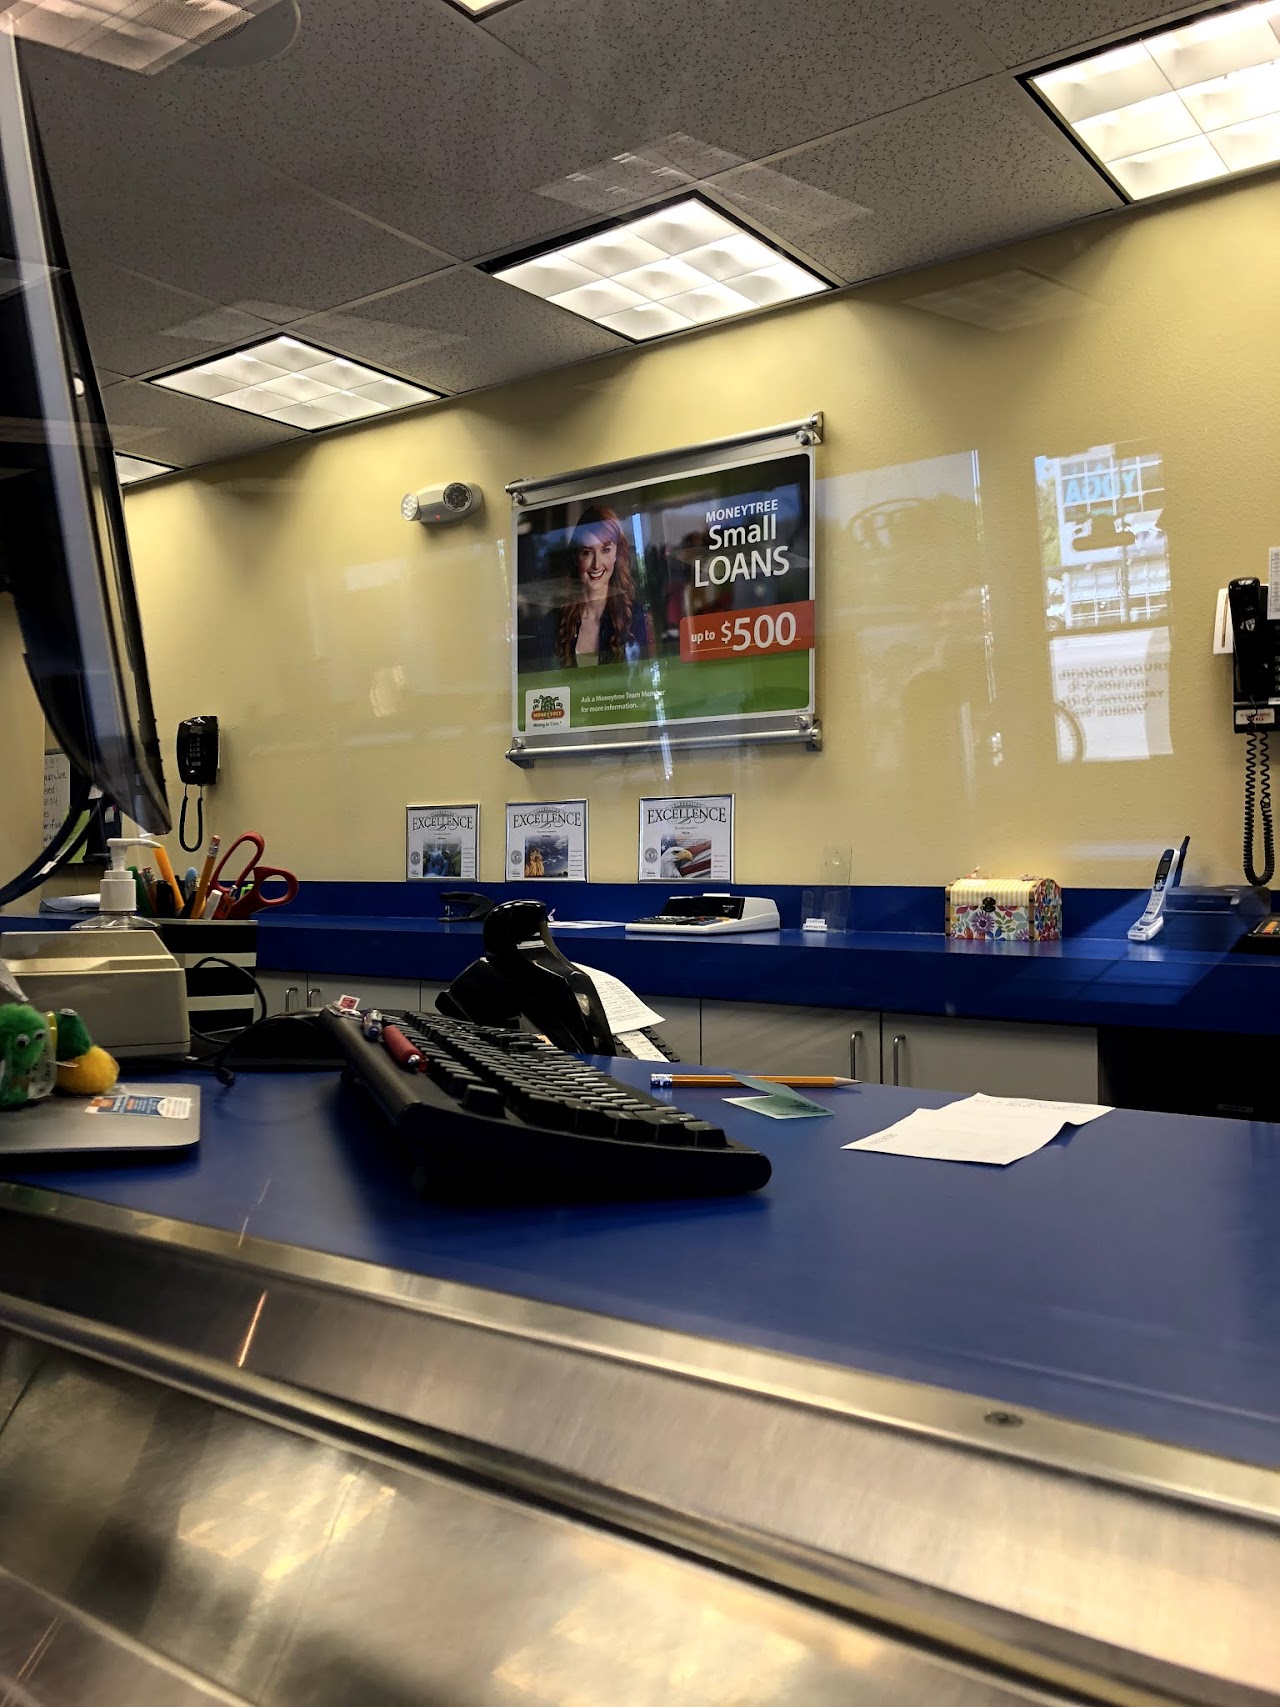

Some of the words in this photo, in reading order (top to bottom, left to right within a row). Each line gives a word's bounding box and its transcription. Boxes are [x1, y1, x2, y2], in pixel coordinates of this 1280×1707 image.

[705, 499, 779, 523] MONEYTREE
[708, 513, 777, 551] Small
[694, 545, 790, 588] LOANS
[691, 633, 704, 645] up
[704, 630, 716, 641] to
[721, 611, 797, 651] $500
[596, 692, 625, 703] Moneytree
[625, 691, 640, 699] Team
[641, 689, 666, 698] Memr
[604, 702, 639, 711] information.
[411, 816, 474, 831] EXCELLENCE
[513, 812, 582, 829] EXCELLENCE
[647, 807, 727, 824] EXCELLENCE
